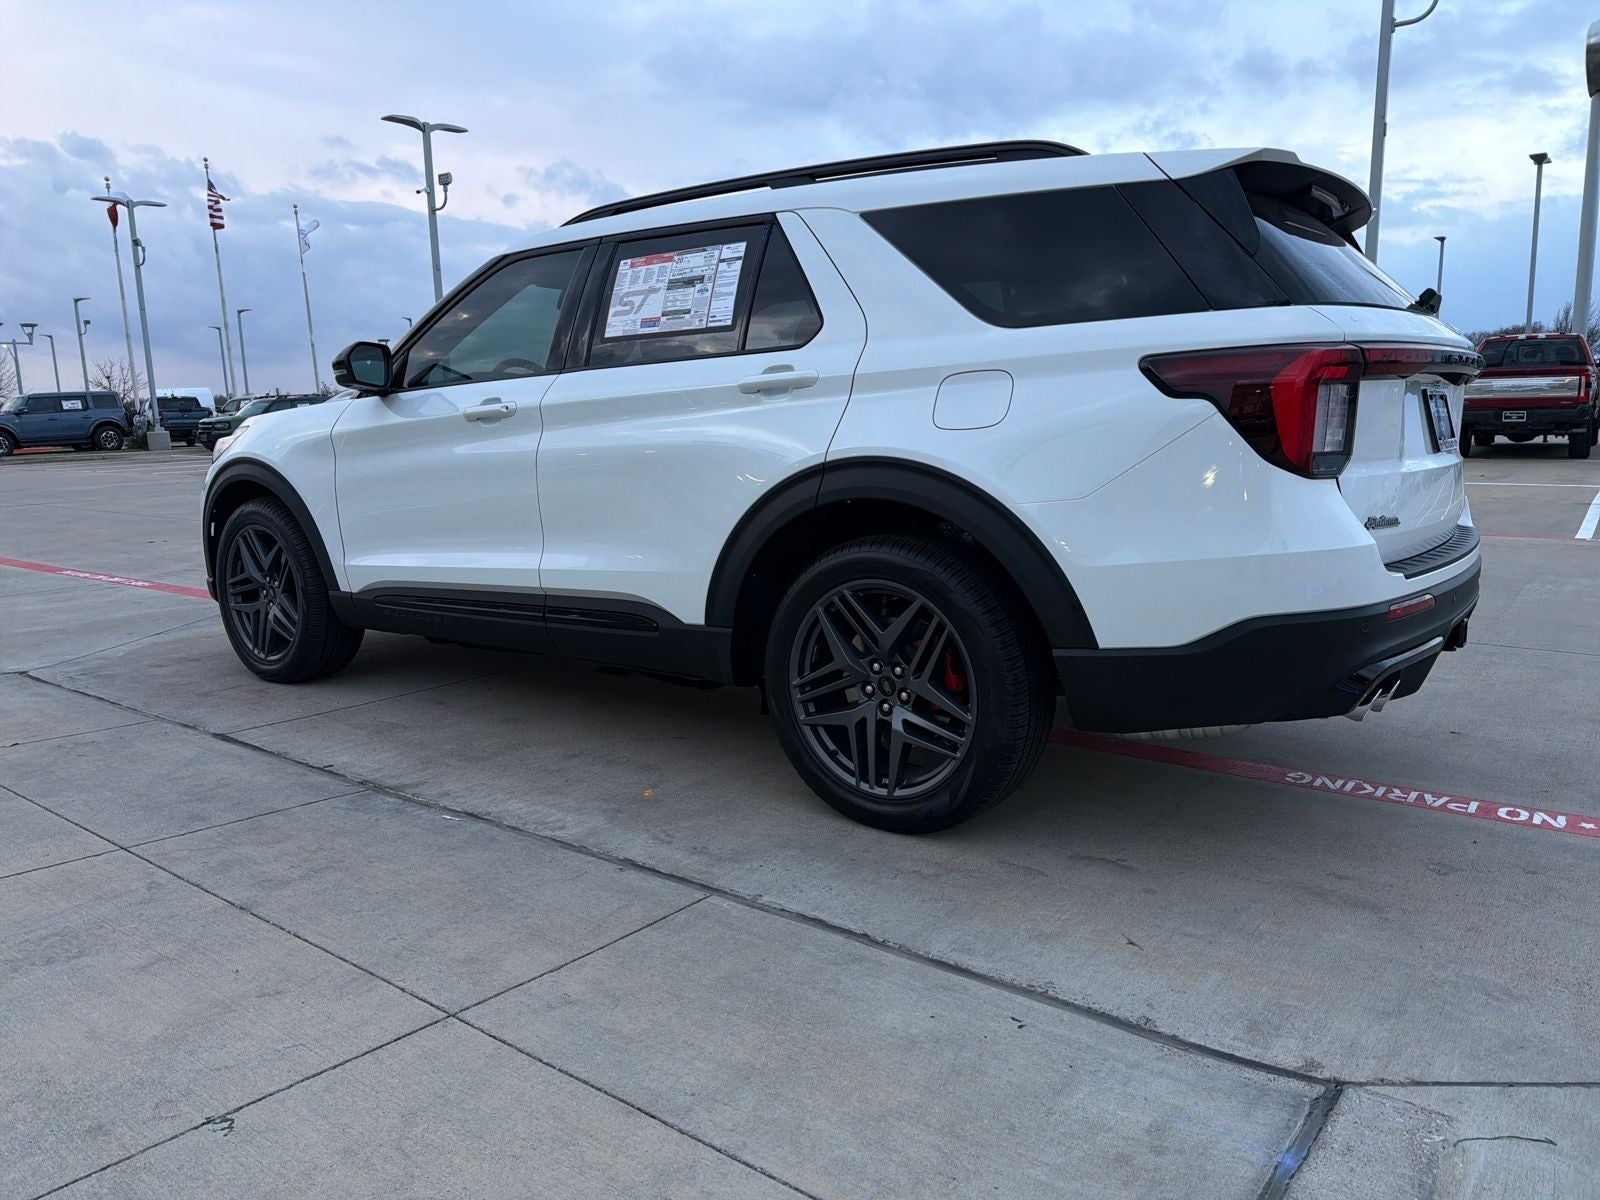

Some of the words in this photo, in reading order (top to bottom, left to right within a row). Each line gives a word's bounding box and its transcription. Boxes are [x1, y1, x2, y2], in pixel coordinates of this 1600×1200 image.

[611, 287, 662, 317] ST
[1284, 771, 1479, 814] PARKING
[1497, 807, 1567, 829] NO
